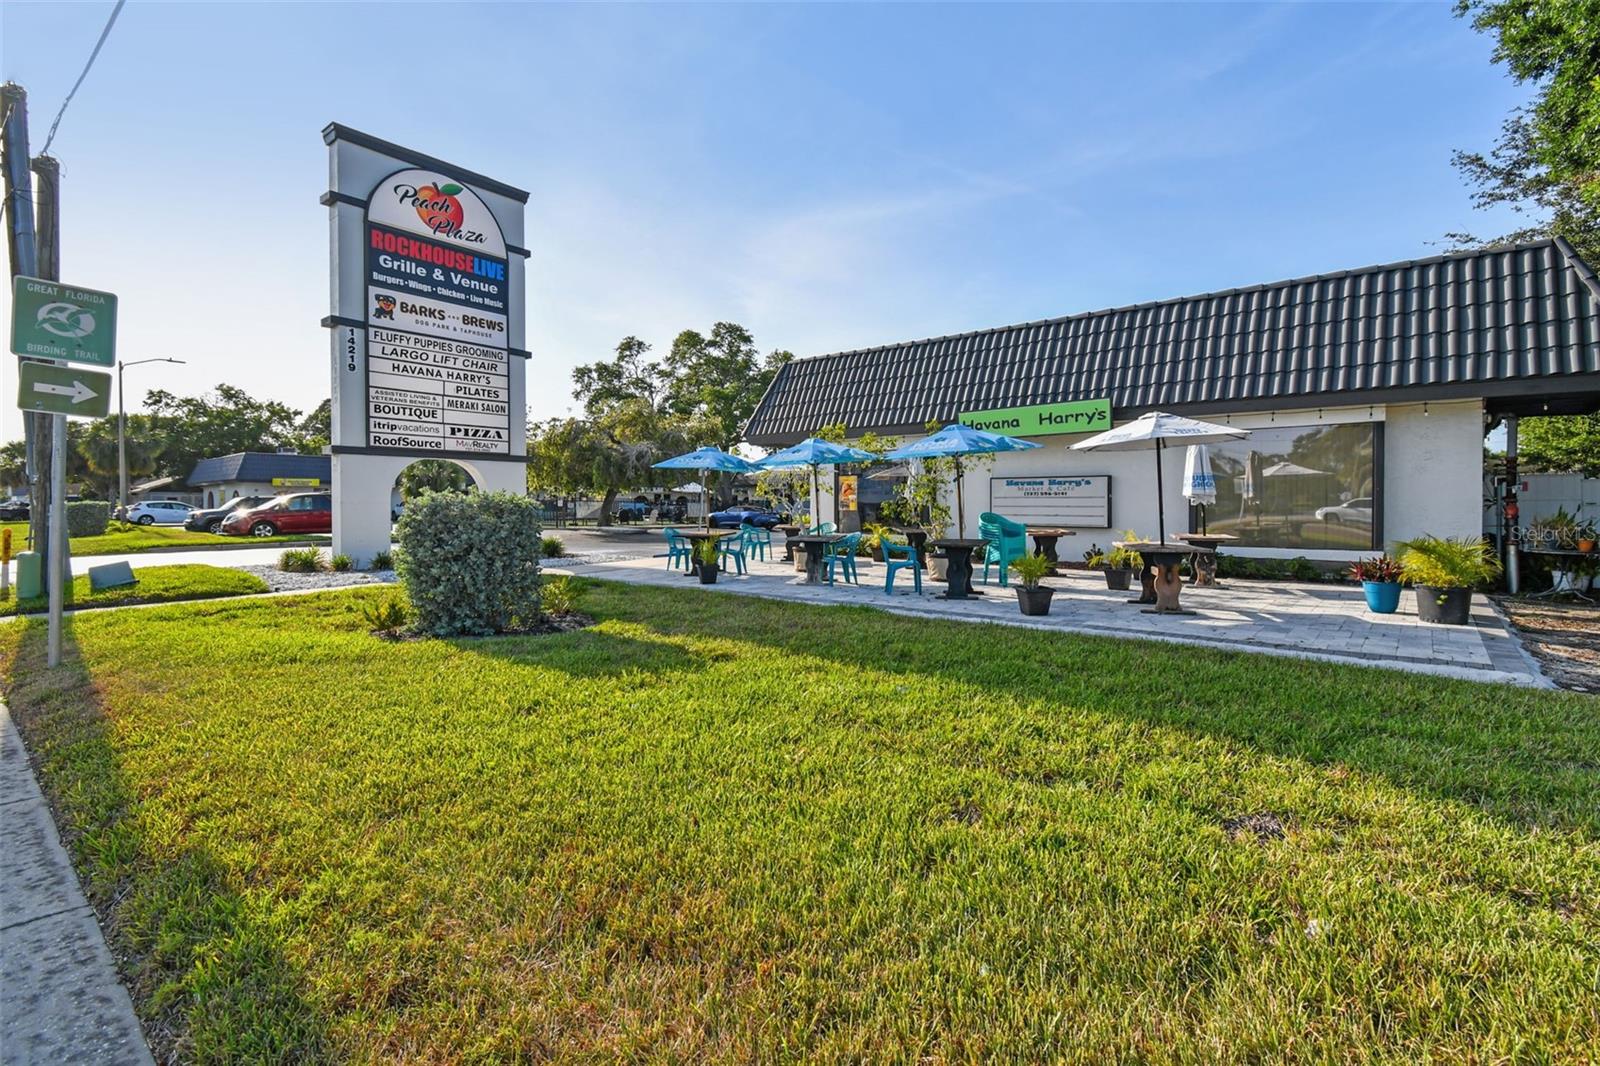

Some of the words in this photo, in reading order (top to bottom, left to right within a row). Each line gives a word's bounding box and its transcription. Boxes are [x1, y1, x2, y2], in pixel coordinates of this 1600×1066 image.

[393, 184, 450, 213] Peach
[428, 215, 488, 244] Plaza
[379, 254, 427, 277] Grille
[432, 268, 446, 282] &
[450, 272, 499, 294] Venue
[27, 282, 59, 296] GREAT
[65, 290, 105, 305] FLORIDA
[372, 271, 404, 286] Burgers
[408, 279, 433, 293] Wings
[437, 286, 466, 301] Chicken
[470, 294, 484, 305] Live
[484, 297, 504, 309] Music
[400, 301, 446, 321] BARKS
[462, 314, 505, 333] BREWS
[414, 319, 430, 328] DOG
[26, 343, 67, 356] BIRDING
[74, 349, 101, 361] TRAIL
[347, 328, 356, 372] 14219
[373, 330, 412, 346] FLUFFY
[413, 337, 454, 353] PUPPIES
[455, 344, 505, 361] GROOMING
[381, 346, 430, 362] LARGO
[433, 354, 460, 367] LIFT
[462, 360, 499, 373] CHAIR
[391, 362, 443, 379] HAVANA
[446, 370, 492, 386] HARRY'S
[371, 395, 408, 404] VETERANS
[408, 399, 441, 408] BENEFITS
[374, 389, 409, 398] ASSISTED
[409, 393, 431, 401] LIVING
[455, 385, 500, 399] PILATES
[373, 404, 439, 420] BOUTIQUE
[446, 399, 480, 411] MERAKI
[480, 403, 507, 415] SALON
[1039, 408, 1108, 427] Harry's
[373, 421, 440, 434] itripvacations
[449, 426, 504, 440] PIZZA
[373, 436, 443, 449] RoofSource
